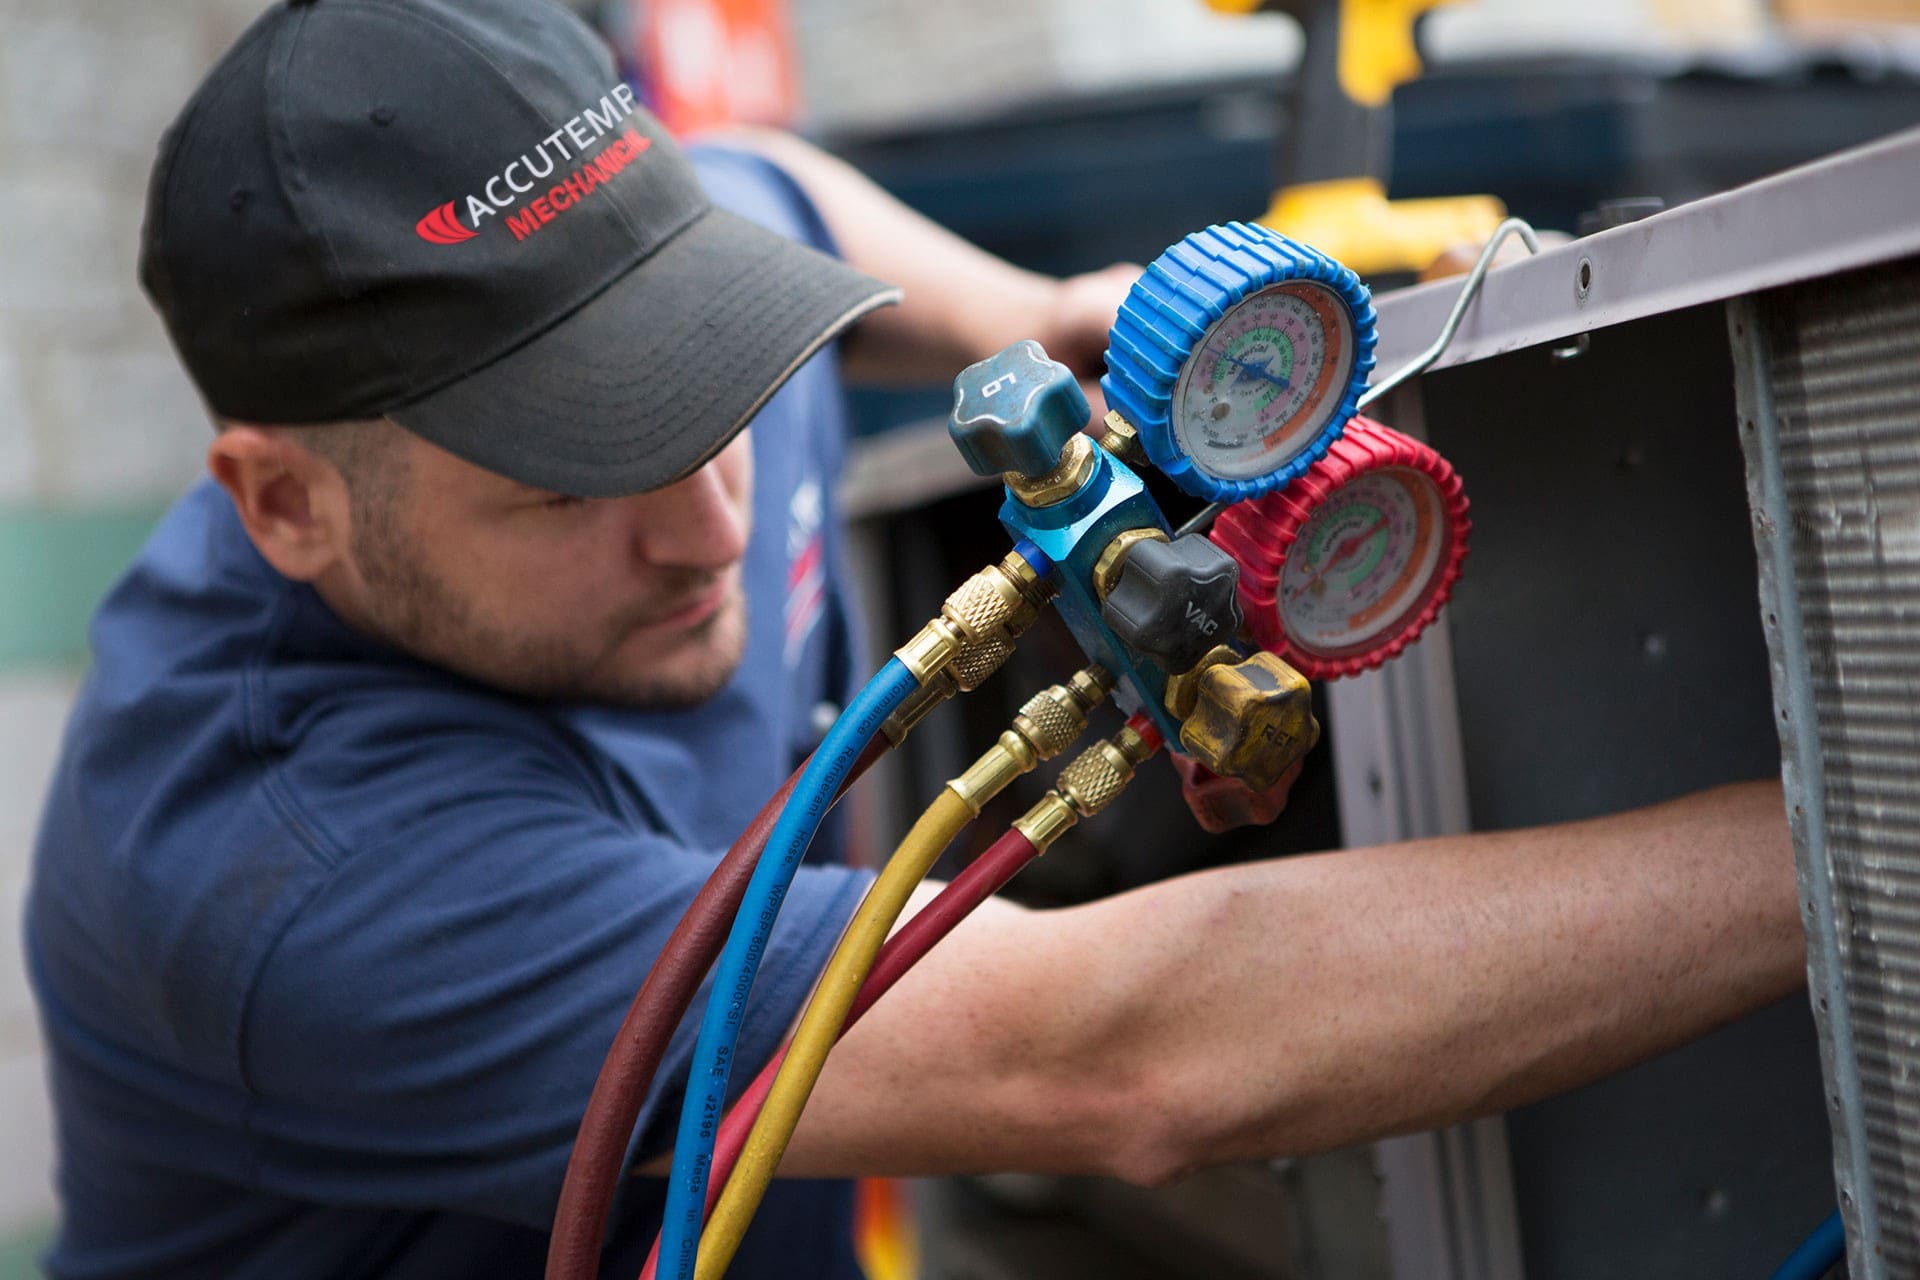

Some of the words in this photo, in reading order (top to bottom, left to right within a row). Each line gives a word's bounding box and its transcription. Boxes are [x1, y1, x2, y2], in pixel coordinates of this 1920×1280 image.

[465, 82, 637, 228] ACCUTEMP
[1184, 600, 1219, 637] VAC
[857, 672, 914, 735] erformance
[808, 744, 855, 818] Refrigerant
[711, 1046, 729, 1077] SAE
[700, 1094, 716, 1140] J2196
